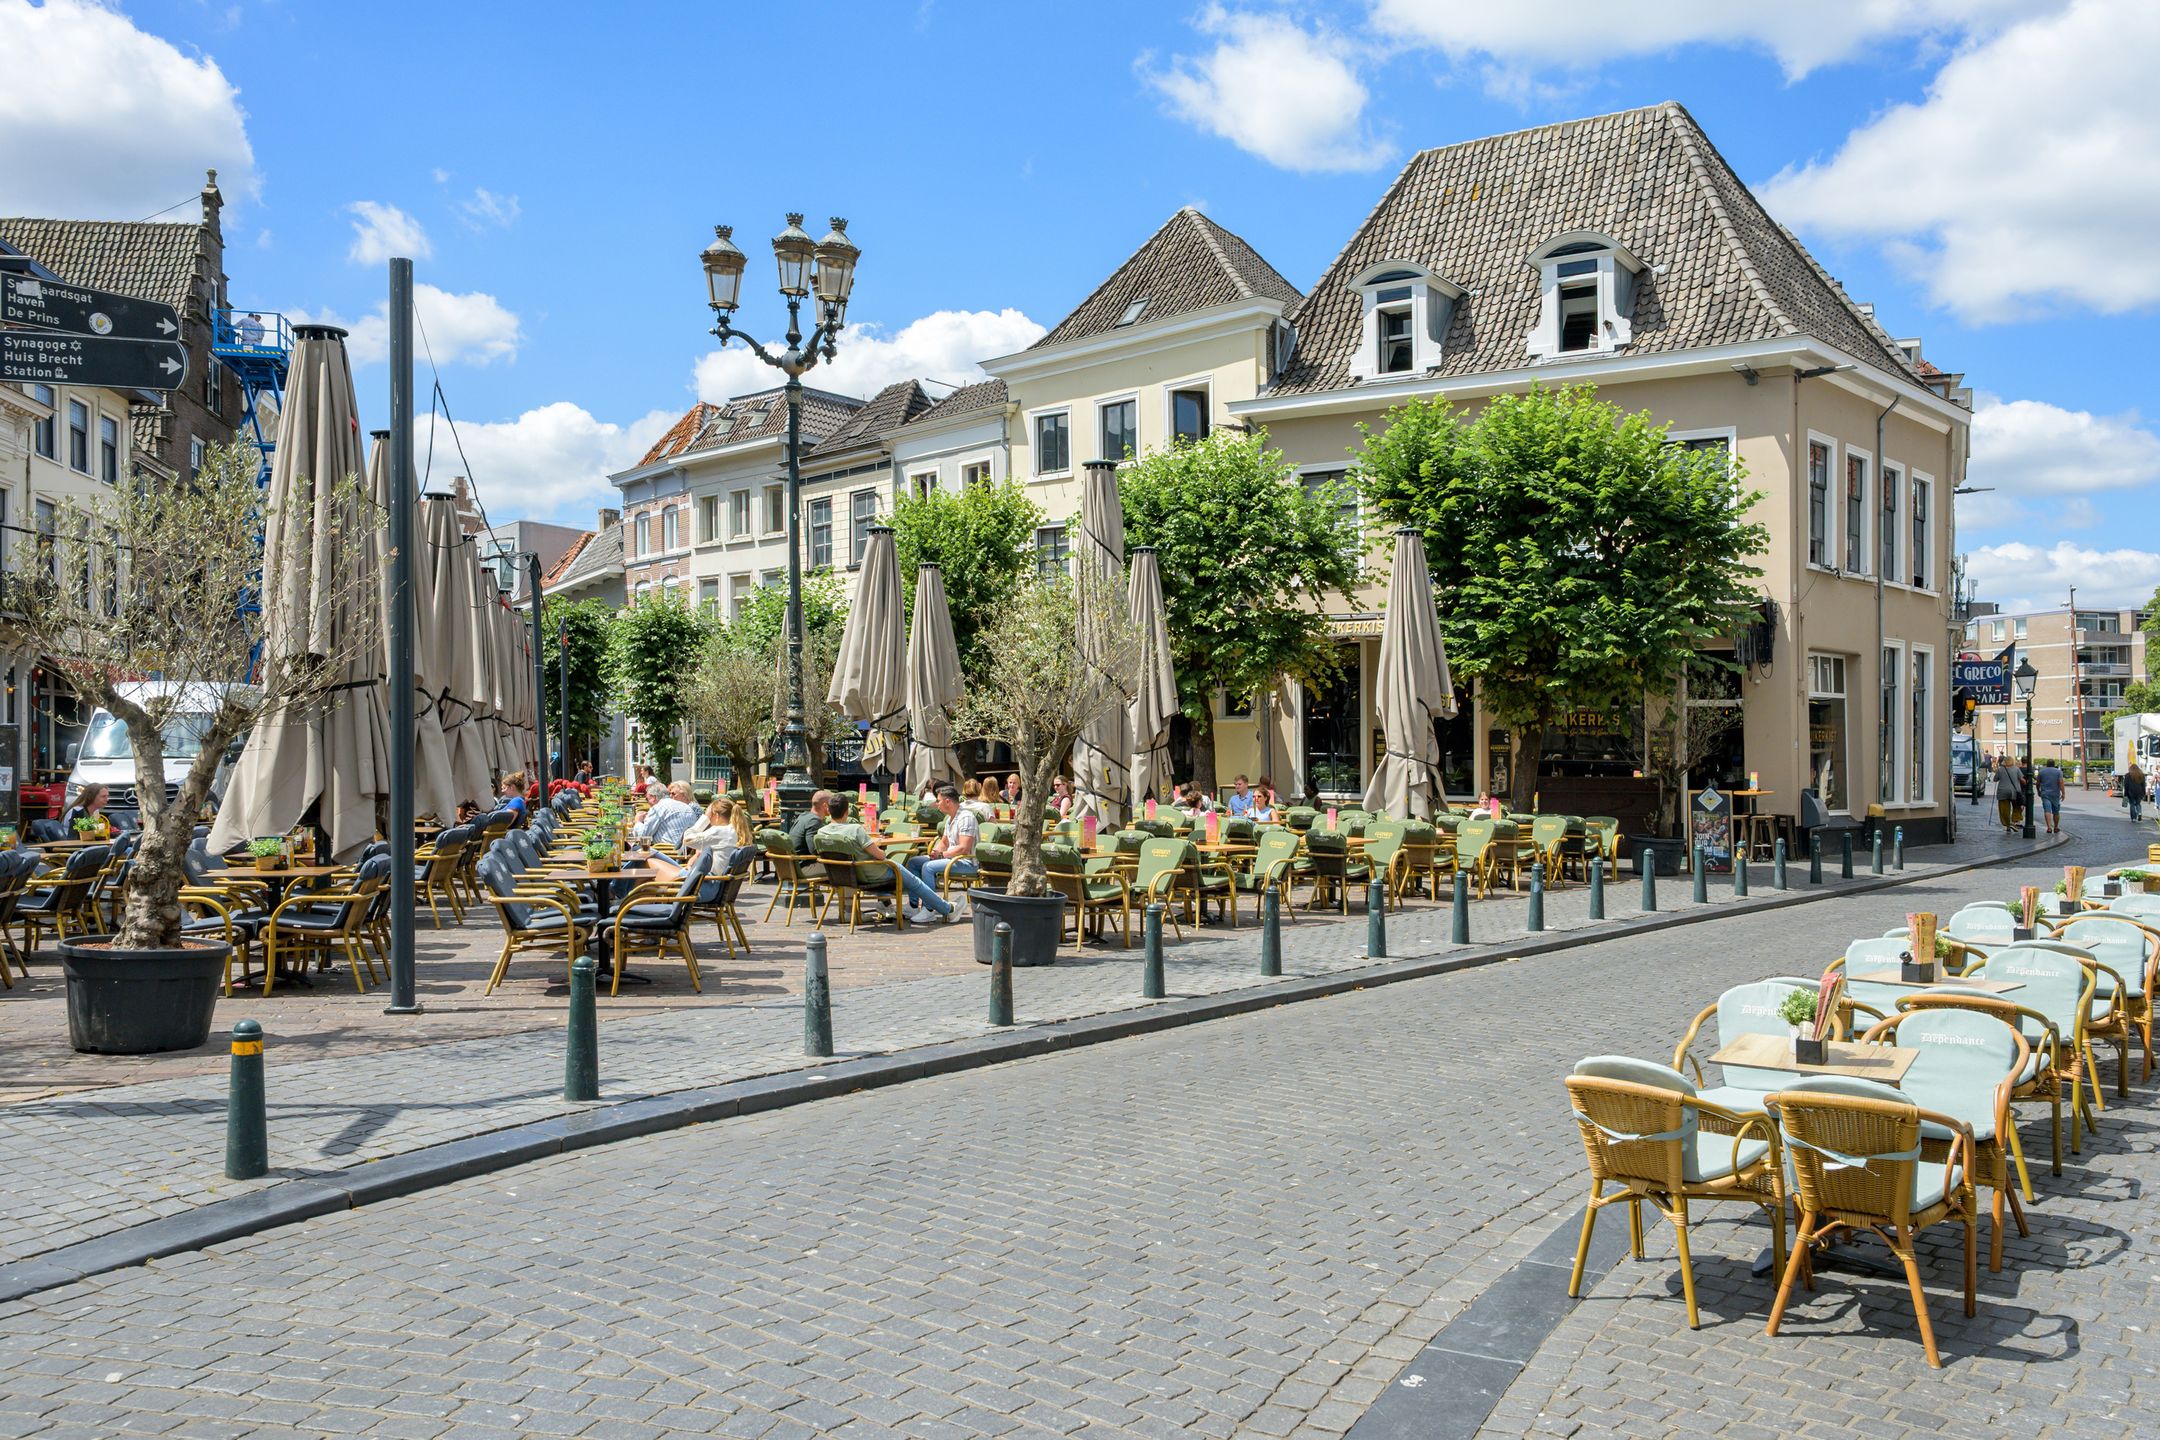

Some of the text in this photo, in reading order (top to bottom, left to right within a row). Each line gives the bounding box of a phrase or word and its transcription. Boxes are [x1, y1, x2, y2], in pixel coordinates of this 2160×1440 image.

[8, 279, 92, 303] Saardsgat
[8, 292, 45, 308] Haven
[8, 306, 60, 325] De Prins
[4, 336, 67, 353] Synagoge
[4, 351, 83, 365] Huis Brecht
[4, 365, 52, 378] Station
[1964, 666, 2001, 681] GRECO
[1972, 693, 2009, 703] RANJE
